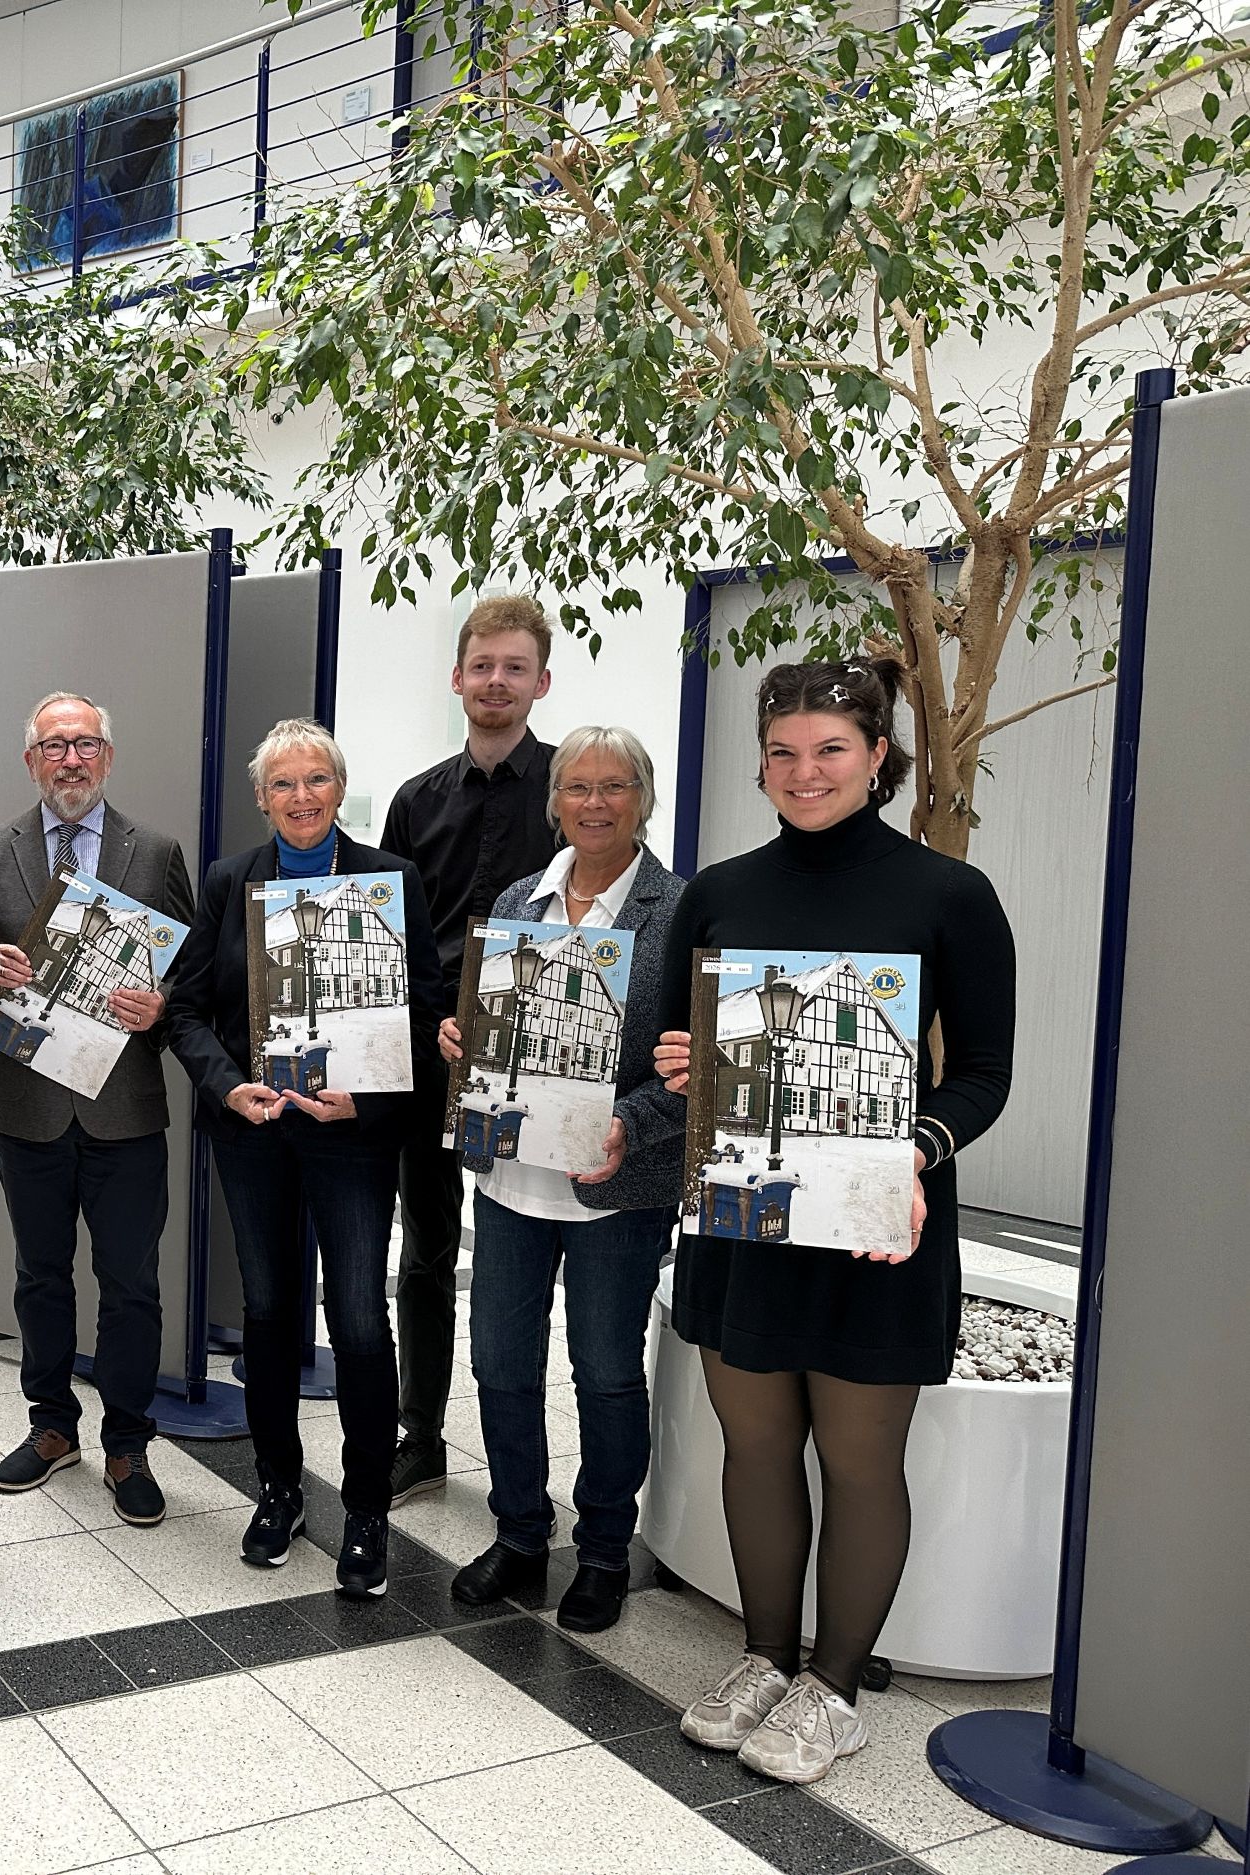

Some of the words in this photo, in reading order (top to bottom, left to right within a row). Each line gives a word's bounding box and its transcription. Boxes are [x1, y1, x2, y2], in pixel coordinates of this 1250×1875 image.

[377, 888, 384, 897] L
[602, 947, 611, 958] L
[880, 976, 892, 989] L
